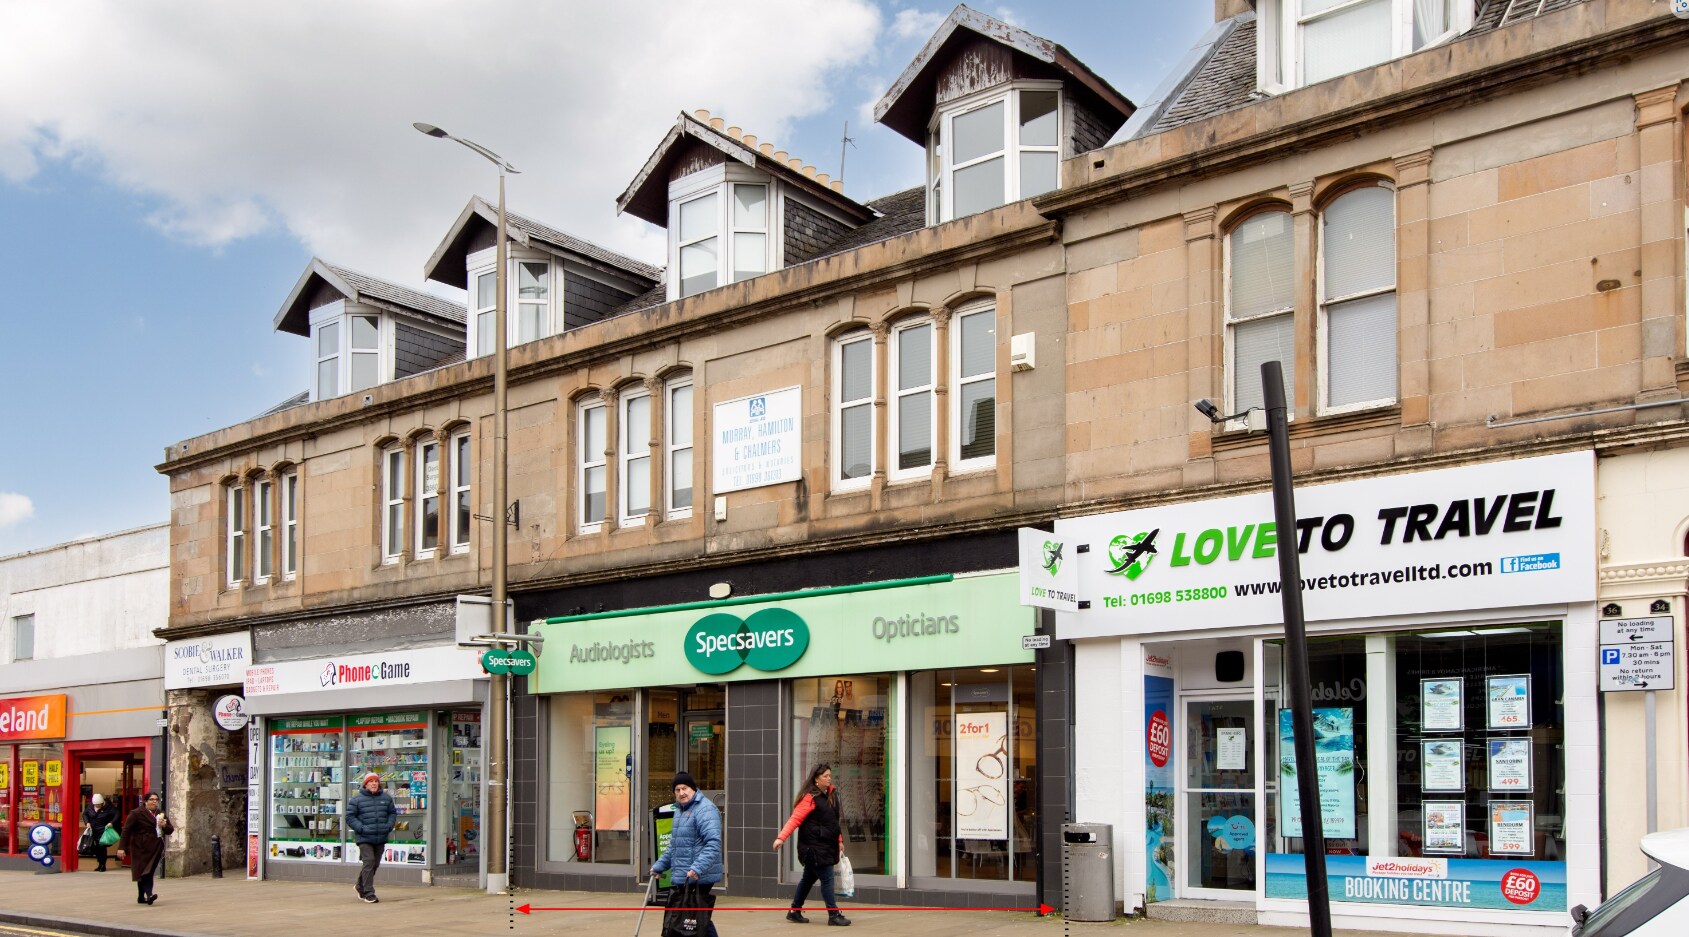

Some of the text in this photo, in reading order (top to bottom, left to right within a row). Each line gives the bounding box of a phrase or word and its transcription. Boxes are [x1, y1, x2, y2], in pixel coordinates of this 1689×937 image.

[758, 417, 794, 437] HAMILTON
[734, 438, 781, 461] & CHALMERS
[1169, 488, 1563, 567] LOVE TO TRAVEL
[1520, 560, 1558, 571] Facebook
[1103, 561, 1493, 608] Tel: 01698 538800 wwwvetotravelltd.com
[1031, 586, 1077, 604] LOVE TO TRAVEL
[1607, 607, 1618, 615] 36
[1654, 603, 1666, 611] 34
[872, 612, 960, 644] Opticians
[174, 640, 244, 664] SCOBIE & WALKER
[569, 639, 656, 665] Audiologists
[695, 628, 795, 658] Specsavers
[488, 655, 531, 668] Specsavers
[1606, 650, 1618, 664] P
[182, 663, 231, 676] DENTAL SURGERY
[338, 661, 410, 683] Phone Game
[0, 703, 49, 733] eland
[657, 711, 670, 719] Men
[249, 728, 259, 741] OPE
[1150, 722, 1169, 746] £60
[253, 742, 259, 764] 7
[1150, 743, 1169, 757] DEPOSIT
[249, 767, 259, 780] DAY
[1345, 876, 1471, 903] BOOKING CENTRE
[1505, 875, 1536, 892] £60
[1504, 888, 1535, 899] DEPOSIT
